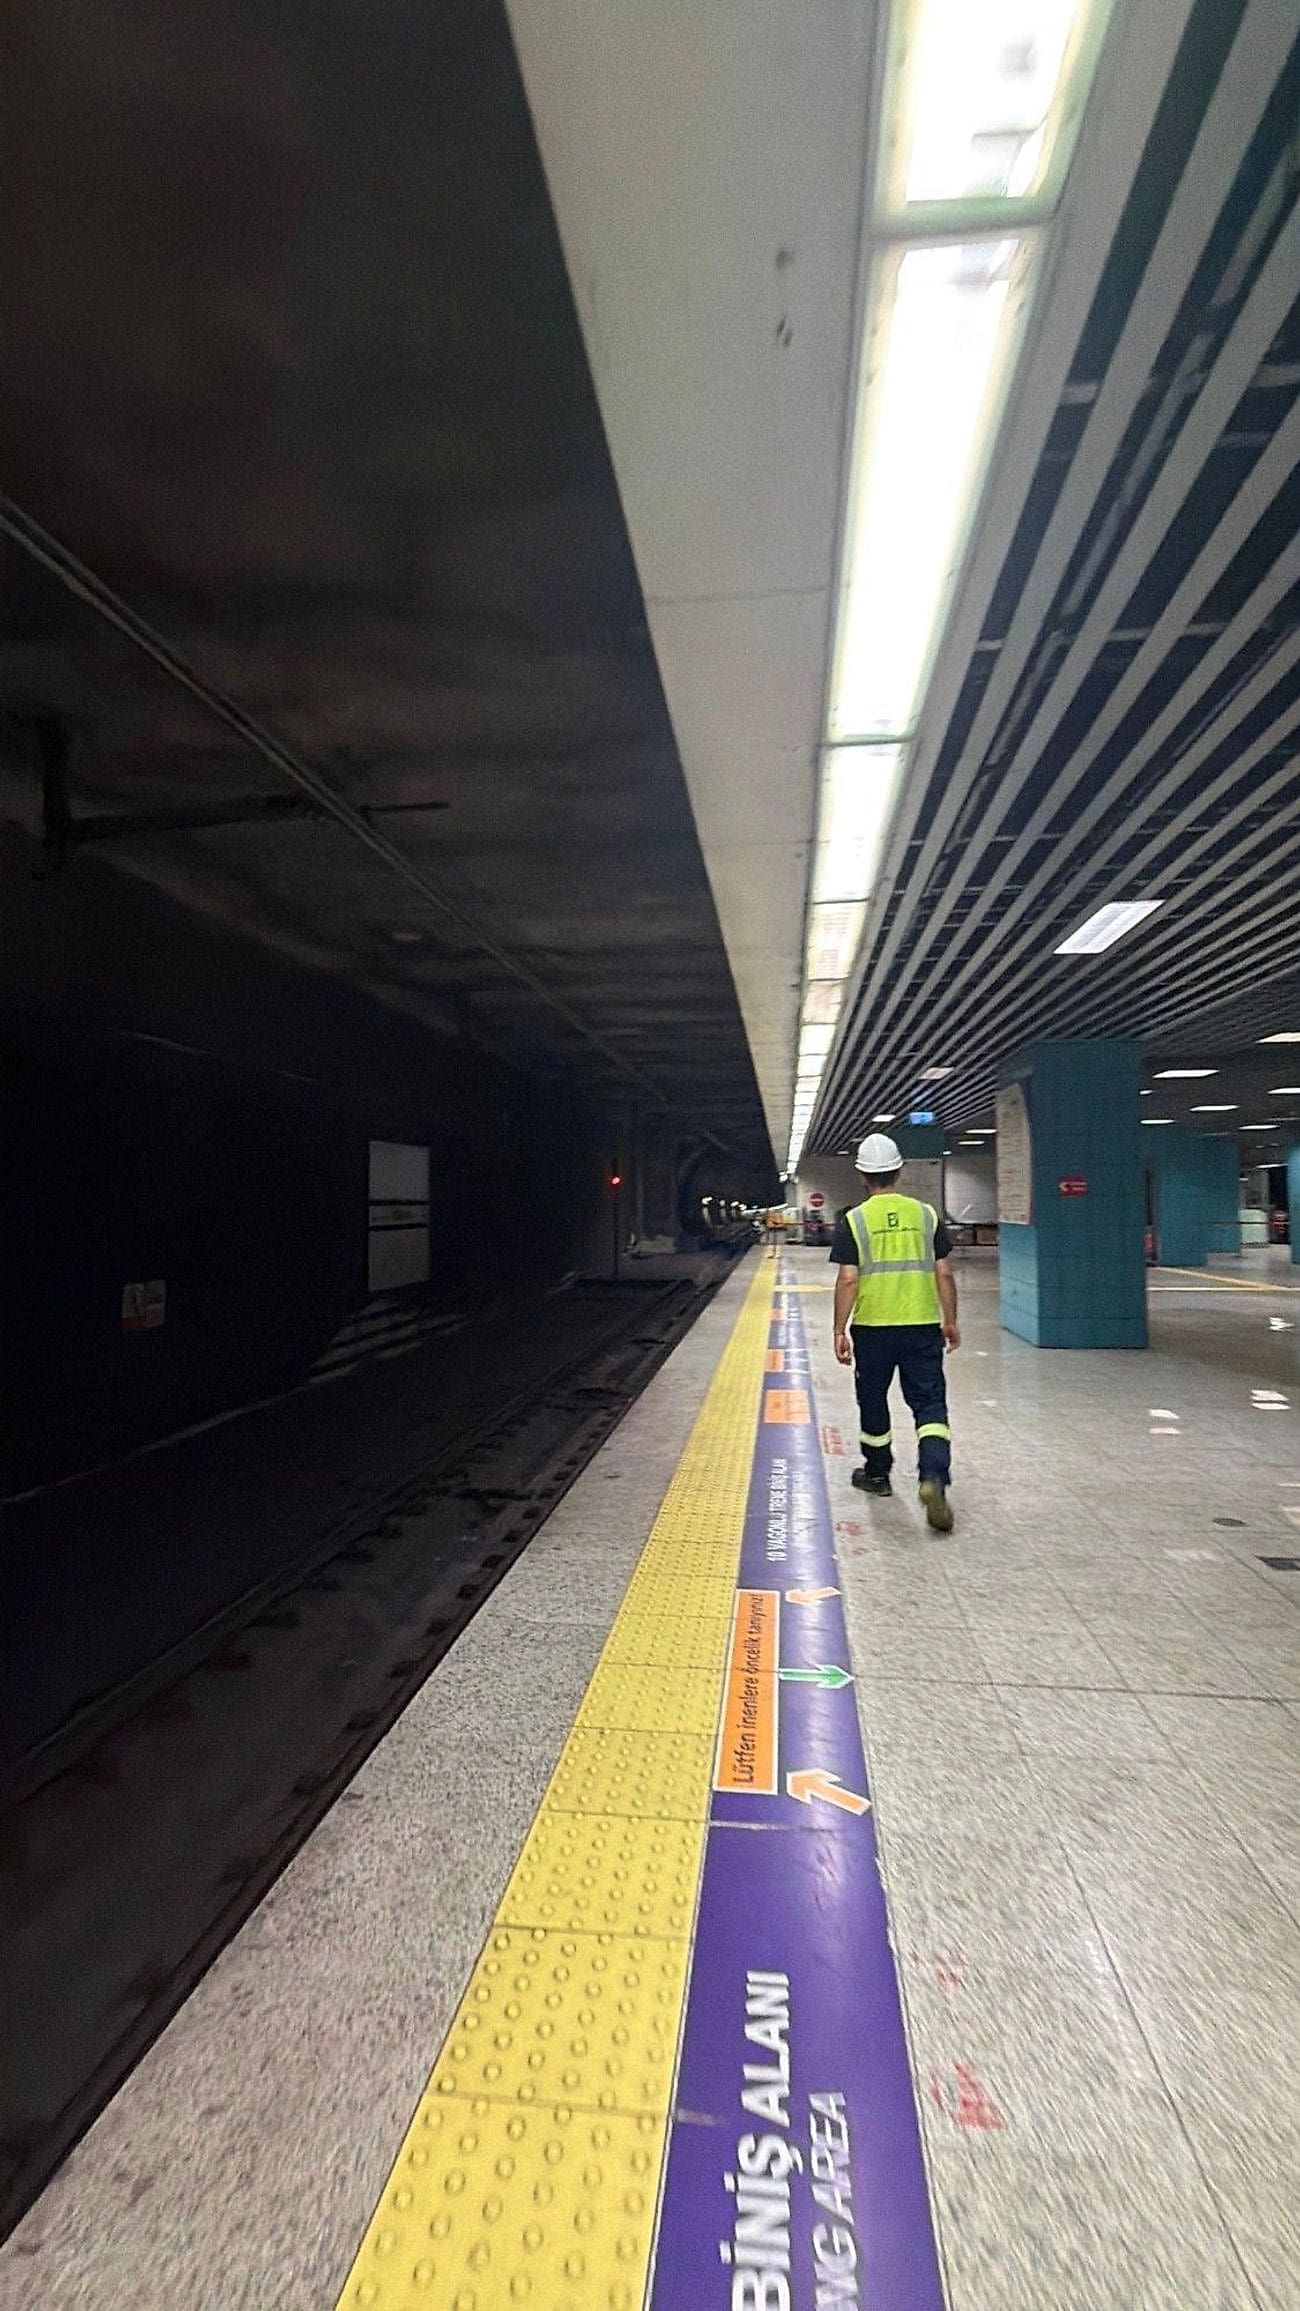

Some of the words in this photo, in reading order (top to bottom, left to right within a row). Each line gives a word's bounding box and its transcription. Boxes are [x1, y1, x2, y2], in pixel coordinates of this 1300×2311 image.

[766, 1552, 788, 1562] 10
[738, 1636, 762, 1675] öncelik
[736, 1678, 759, 1729] inenlere
[732, 1733, 756, 1784] Lütfen
[741, 1970, 791, 2128] ALANI
[808, 2091, 854, 2226] AREA
[719, 2134, 803, 2311] BİNİŞ
